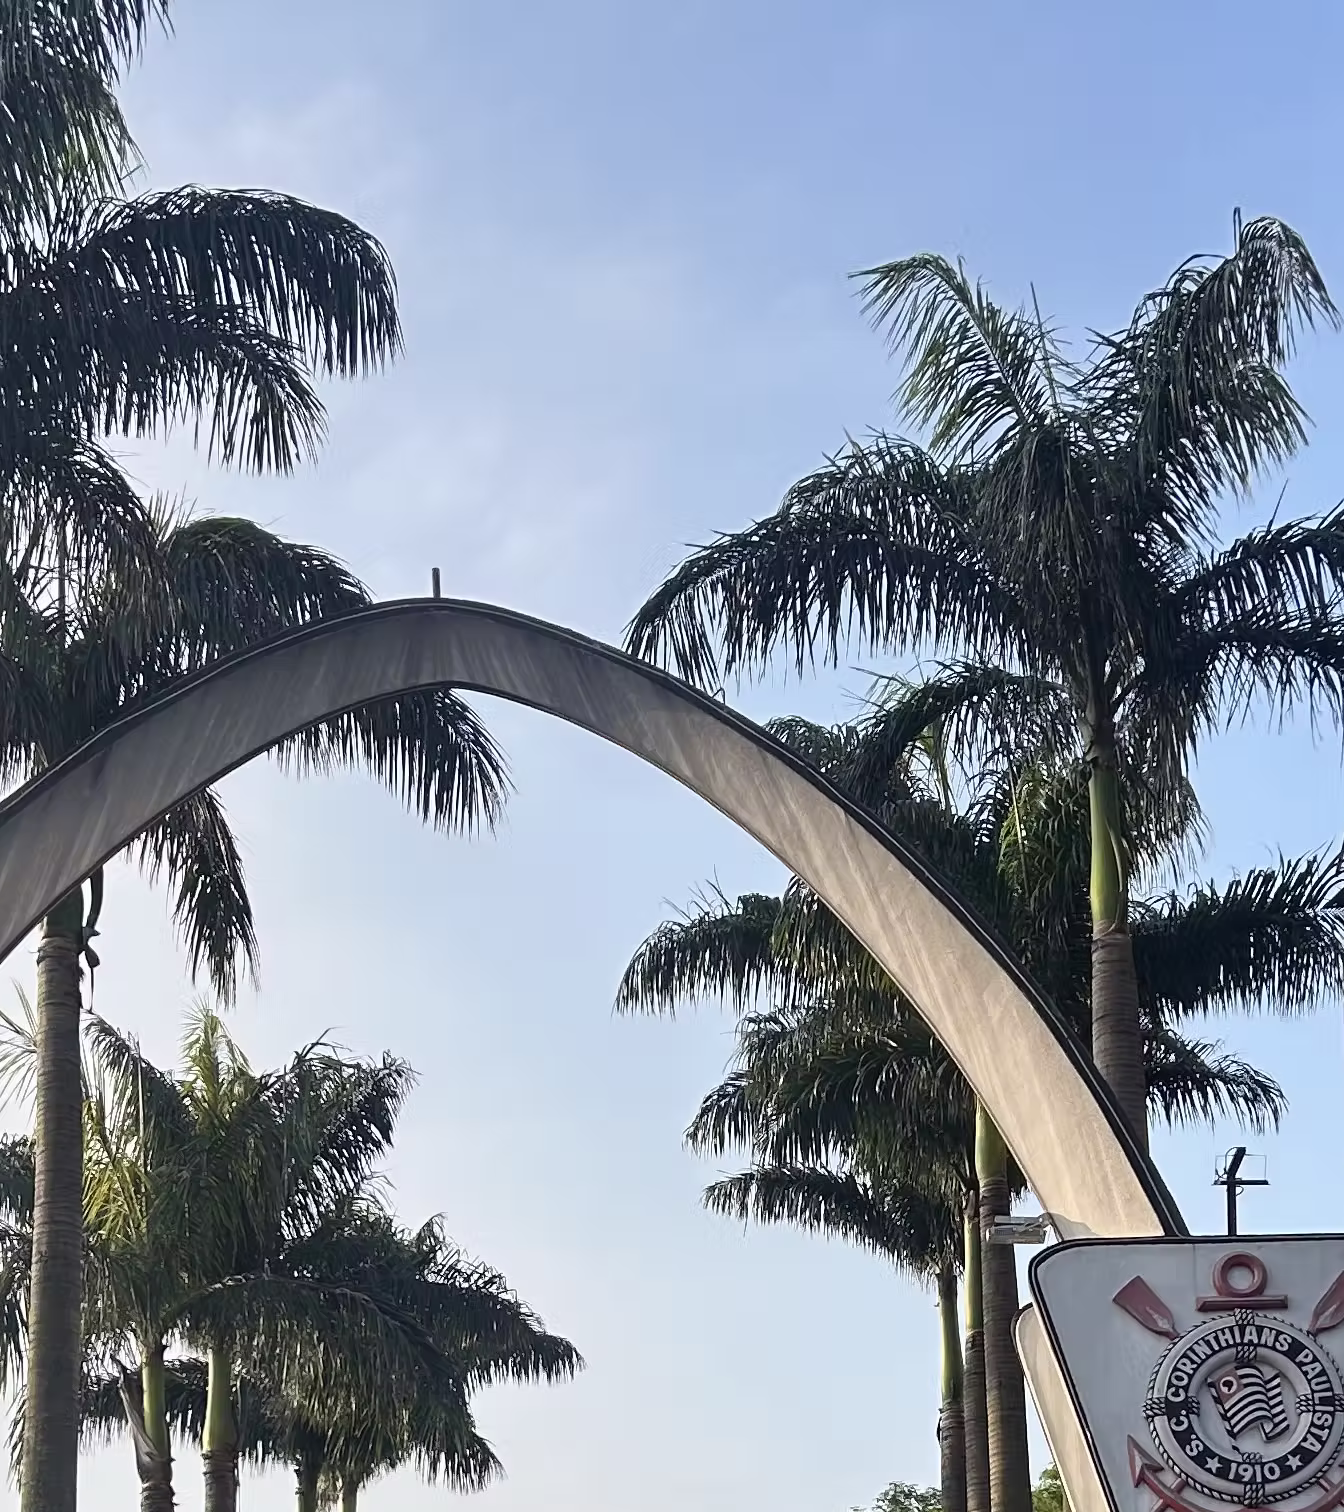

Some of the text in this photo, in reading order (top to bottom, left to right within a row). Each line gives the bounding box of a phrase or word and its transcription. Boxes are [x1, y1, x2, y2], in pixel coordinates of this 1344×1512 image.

[1166, 1325, 1335, 1457] S. C. CORINTHIANS PAULISTA
[1228, 1461, 1281, 1483] 1910
